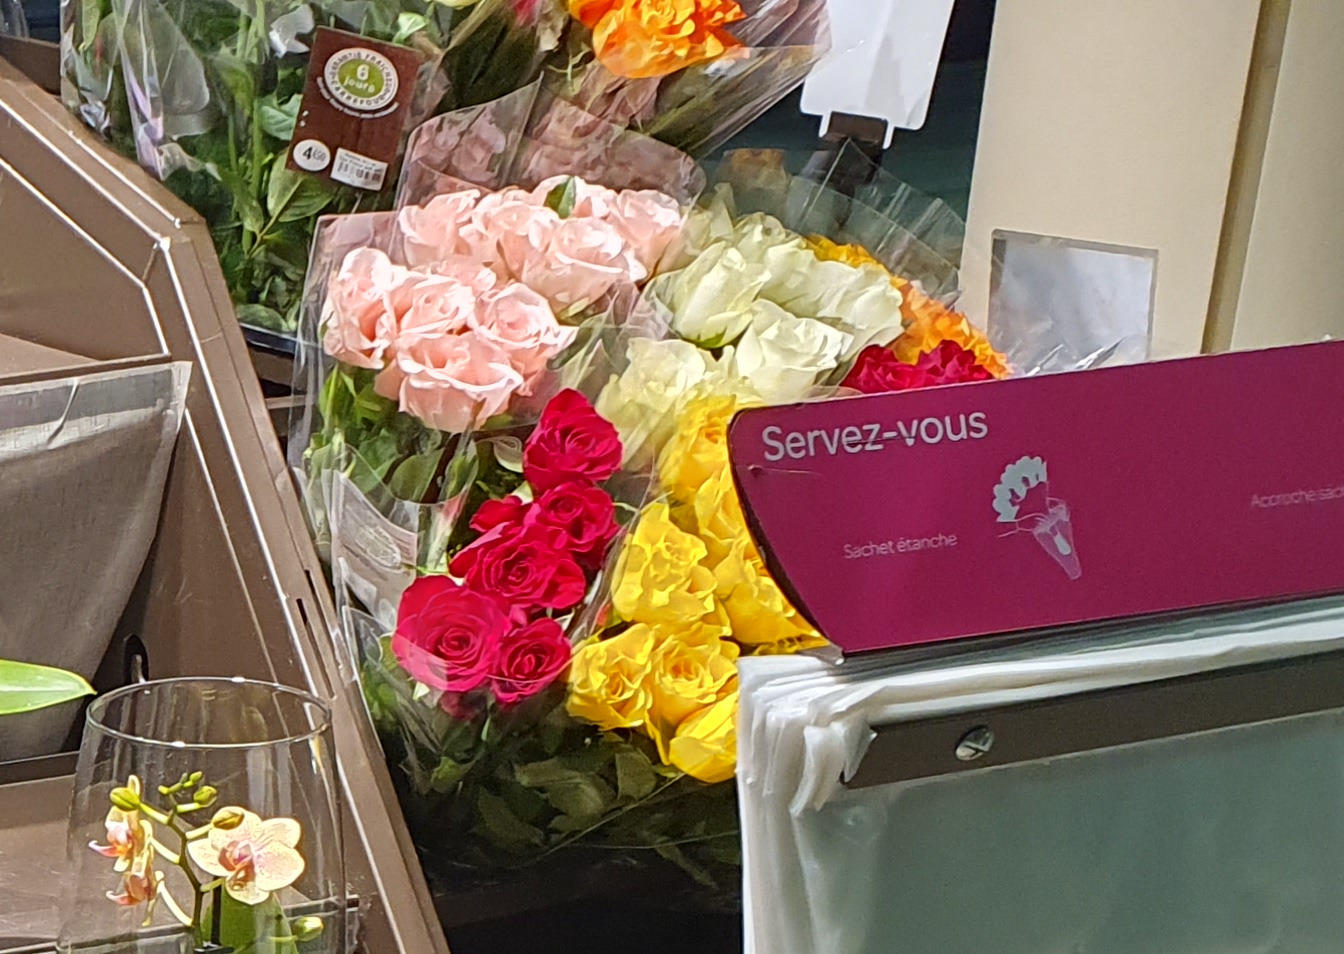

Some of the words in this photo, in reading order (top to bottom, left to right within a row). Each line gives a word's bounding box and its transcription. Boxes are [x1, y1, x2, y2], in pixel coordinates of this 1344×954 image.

[356, 63, 370, 81] 6
[762, 410, 989, 463] Servez-vous
[843, 541, 895, 559] Sachet
[896, 533, 958, 553] étanche
